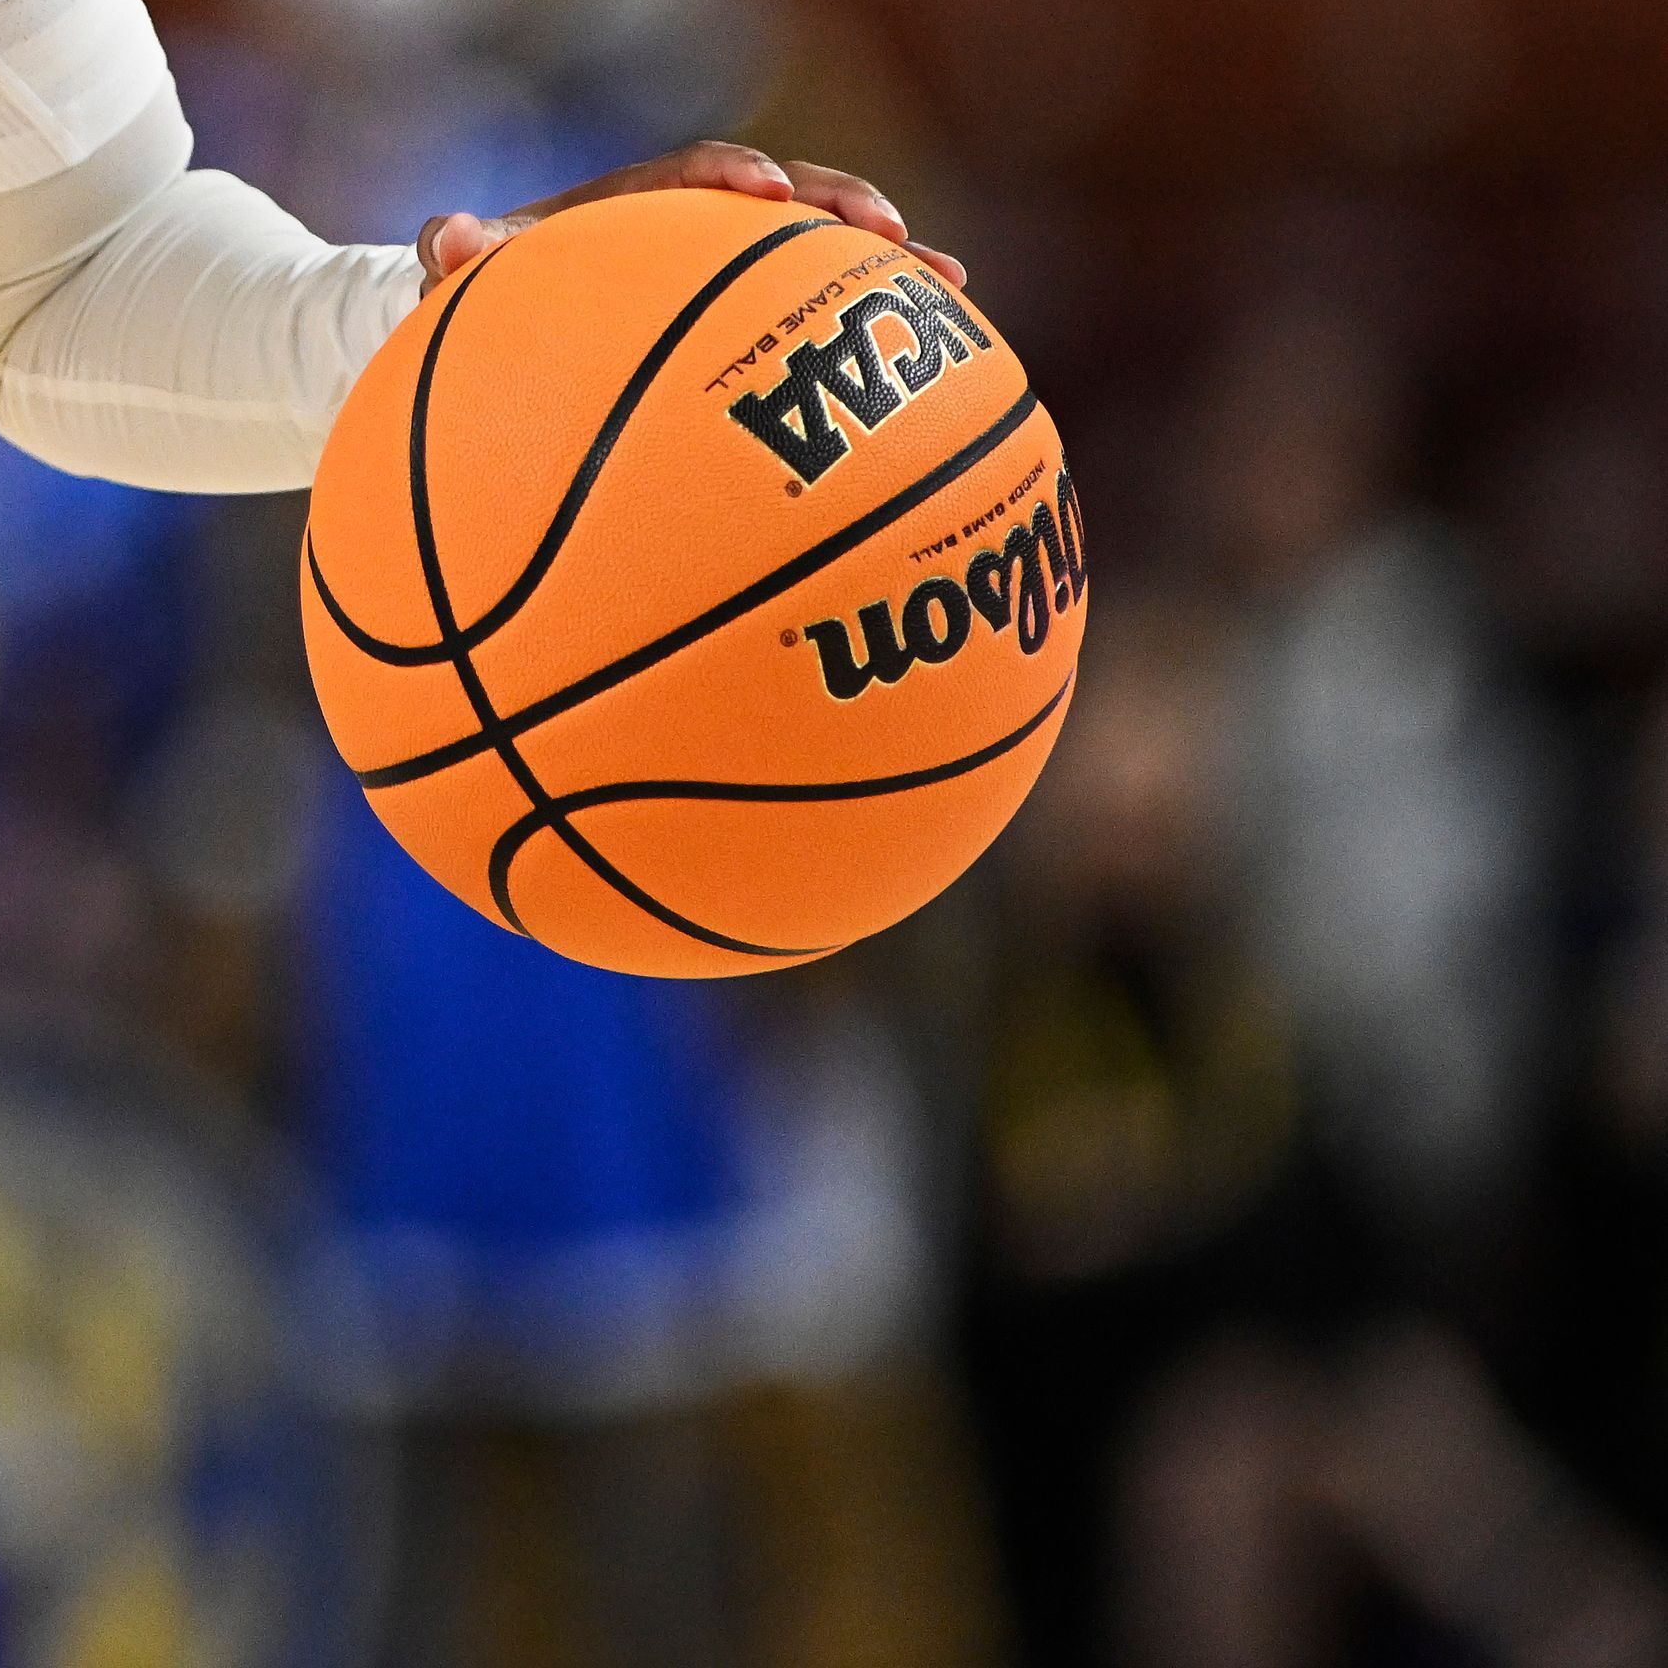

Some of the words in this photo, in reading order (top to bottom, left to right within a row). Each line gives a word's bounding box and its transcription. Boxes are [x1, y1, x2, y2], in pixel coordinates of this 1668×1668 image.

[776, 280, 845, 335] GAME
[705, 333, 779, 393] BALL
[727, 267, 993, 487] NCAA
[962, 501, 1006, 539] GAME
[908, 533, 958, 564] BALL
